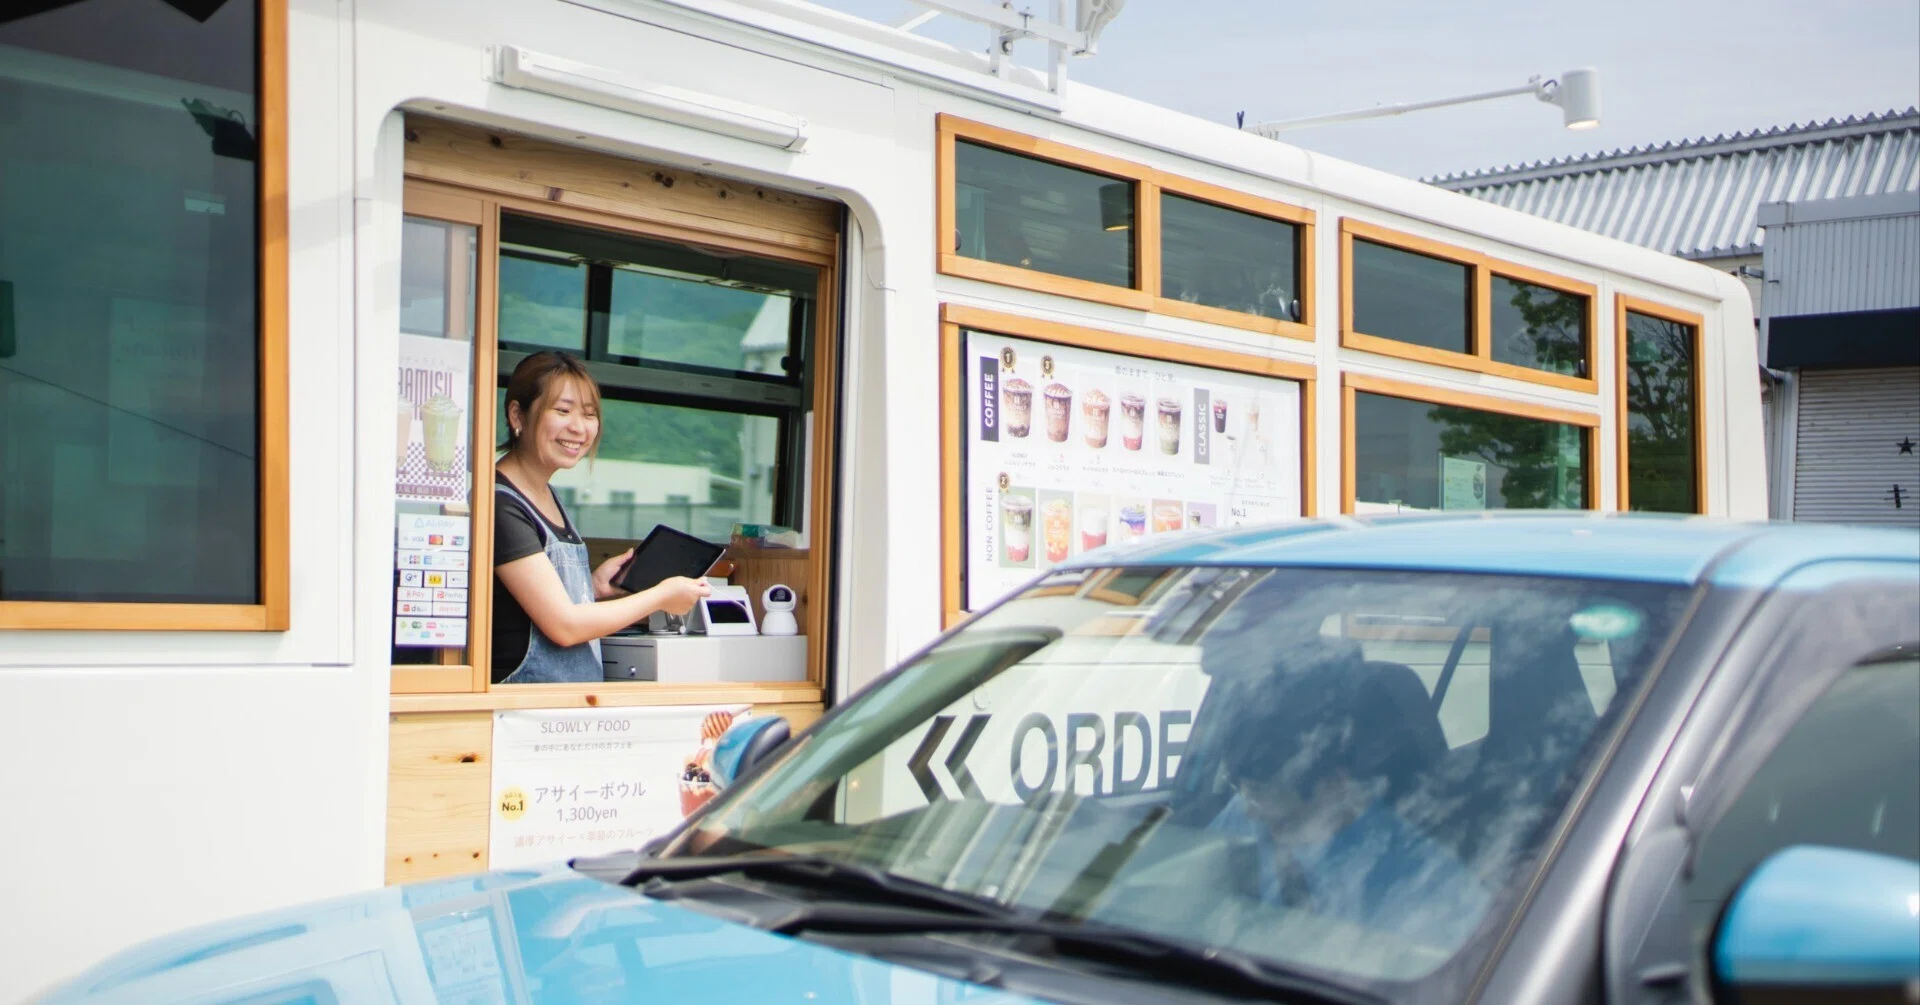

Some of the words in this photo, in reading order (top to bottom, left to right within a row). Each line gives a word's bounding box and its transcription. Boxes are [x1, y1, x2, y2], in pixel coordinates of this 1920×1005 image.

[984, 373, 994, 428] COFFEE
[1198, 403, 1206, 456] CLASSIC
[1231, 508, 1246, 518] No.1
[541, 720, 590, 734] SLOWLY
[597, 719, 630, 733] FOOD
[534, 781, 647, 804] アサイーボウル
[501, 800, 524, 812] No.1
[556, 806, 617, 823] 1,300yen
